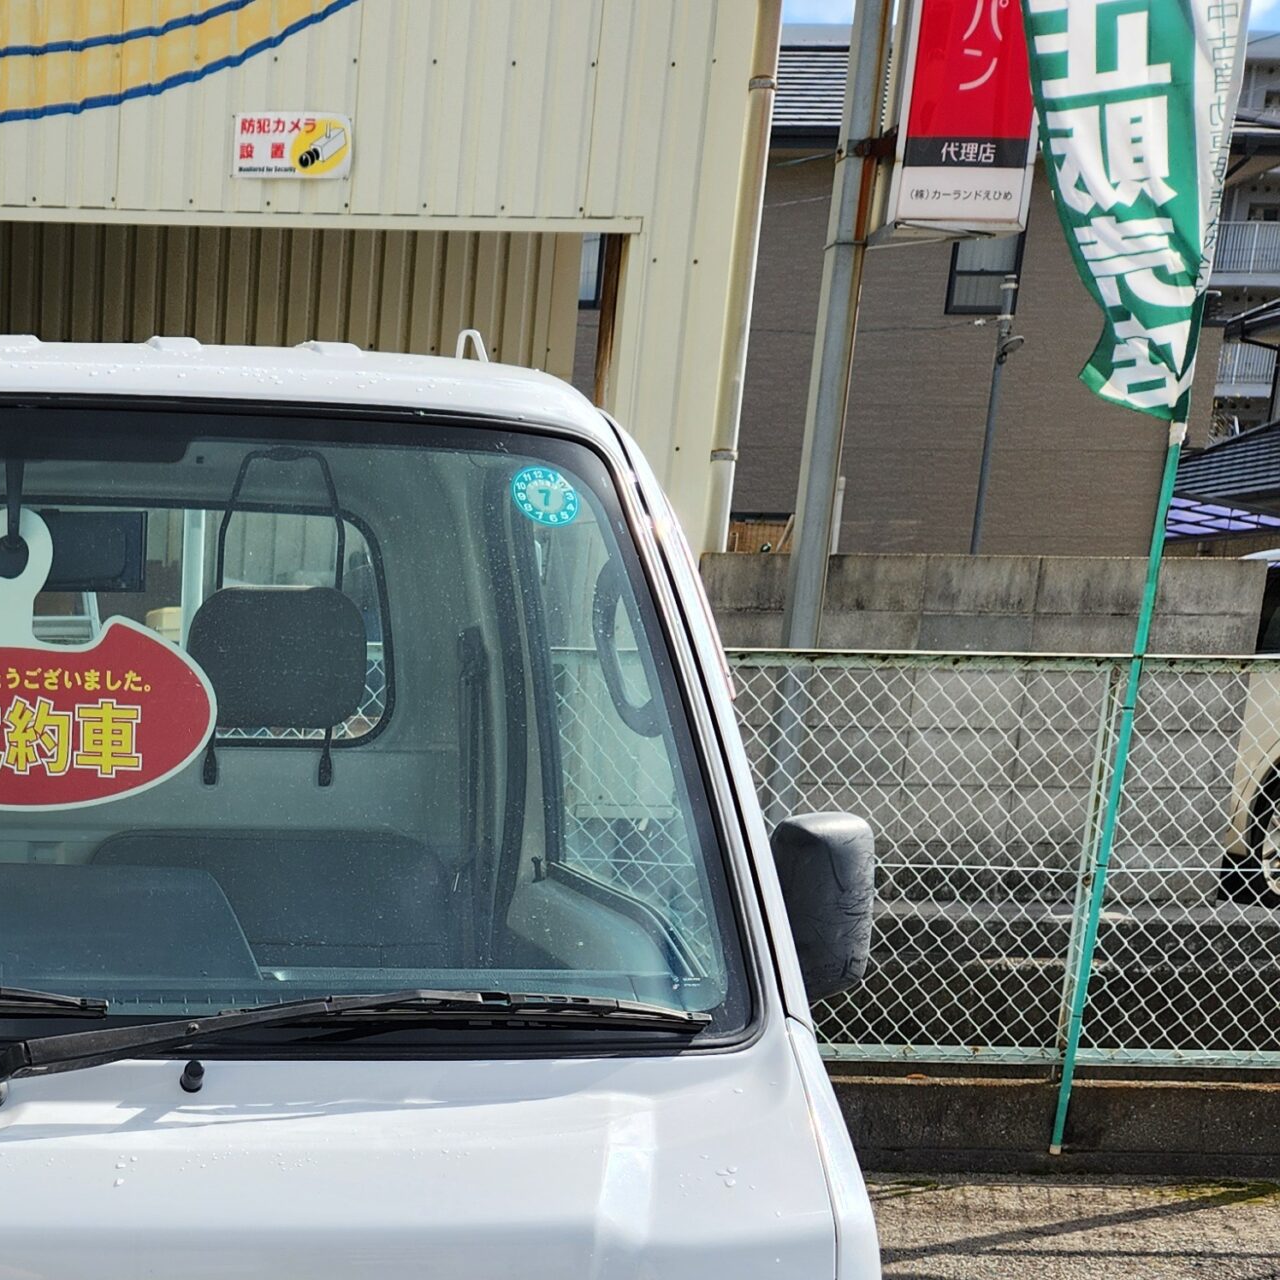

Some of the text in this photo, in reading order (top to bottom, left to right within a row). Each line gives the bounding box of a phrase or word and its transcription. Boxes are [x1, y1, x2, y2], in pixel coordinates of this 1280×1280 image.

[240, 118, 317, 135] 防犯カメラ
[941, 141, 997, 163] 代理店
[538, 488, 551, 507] 7
